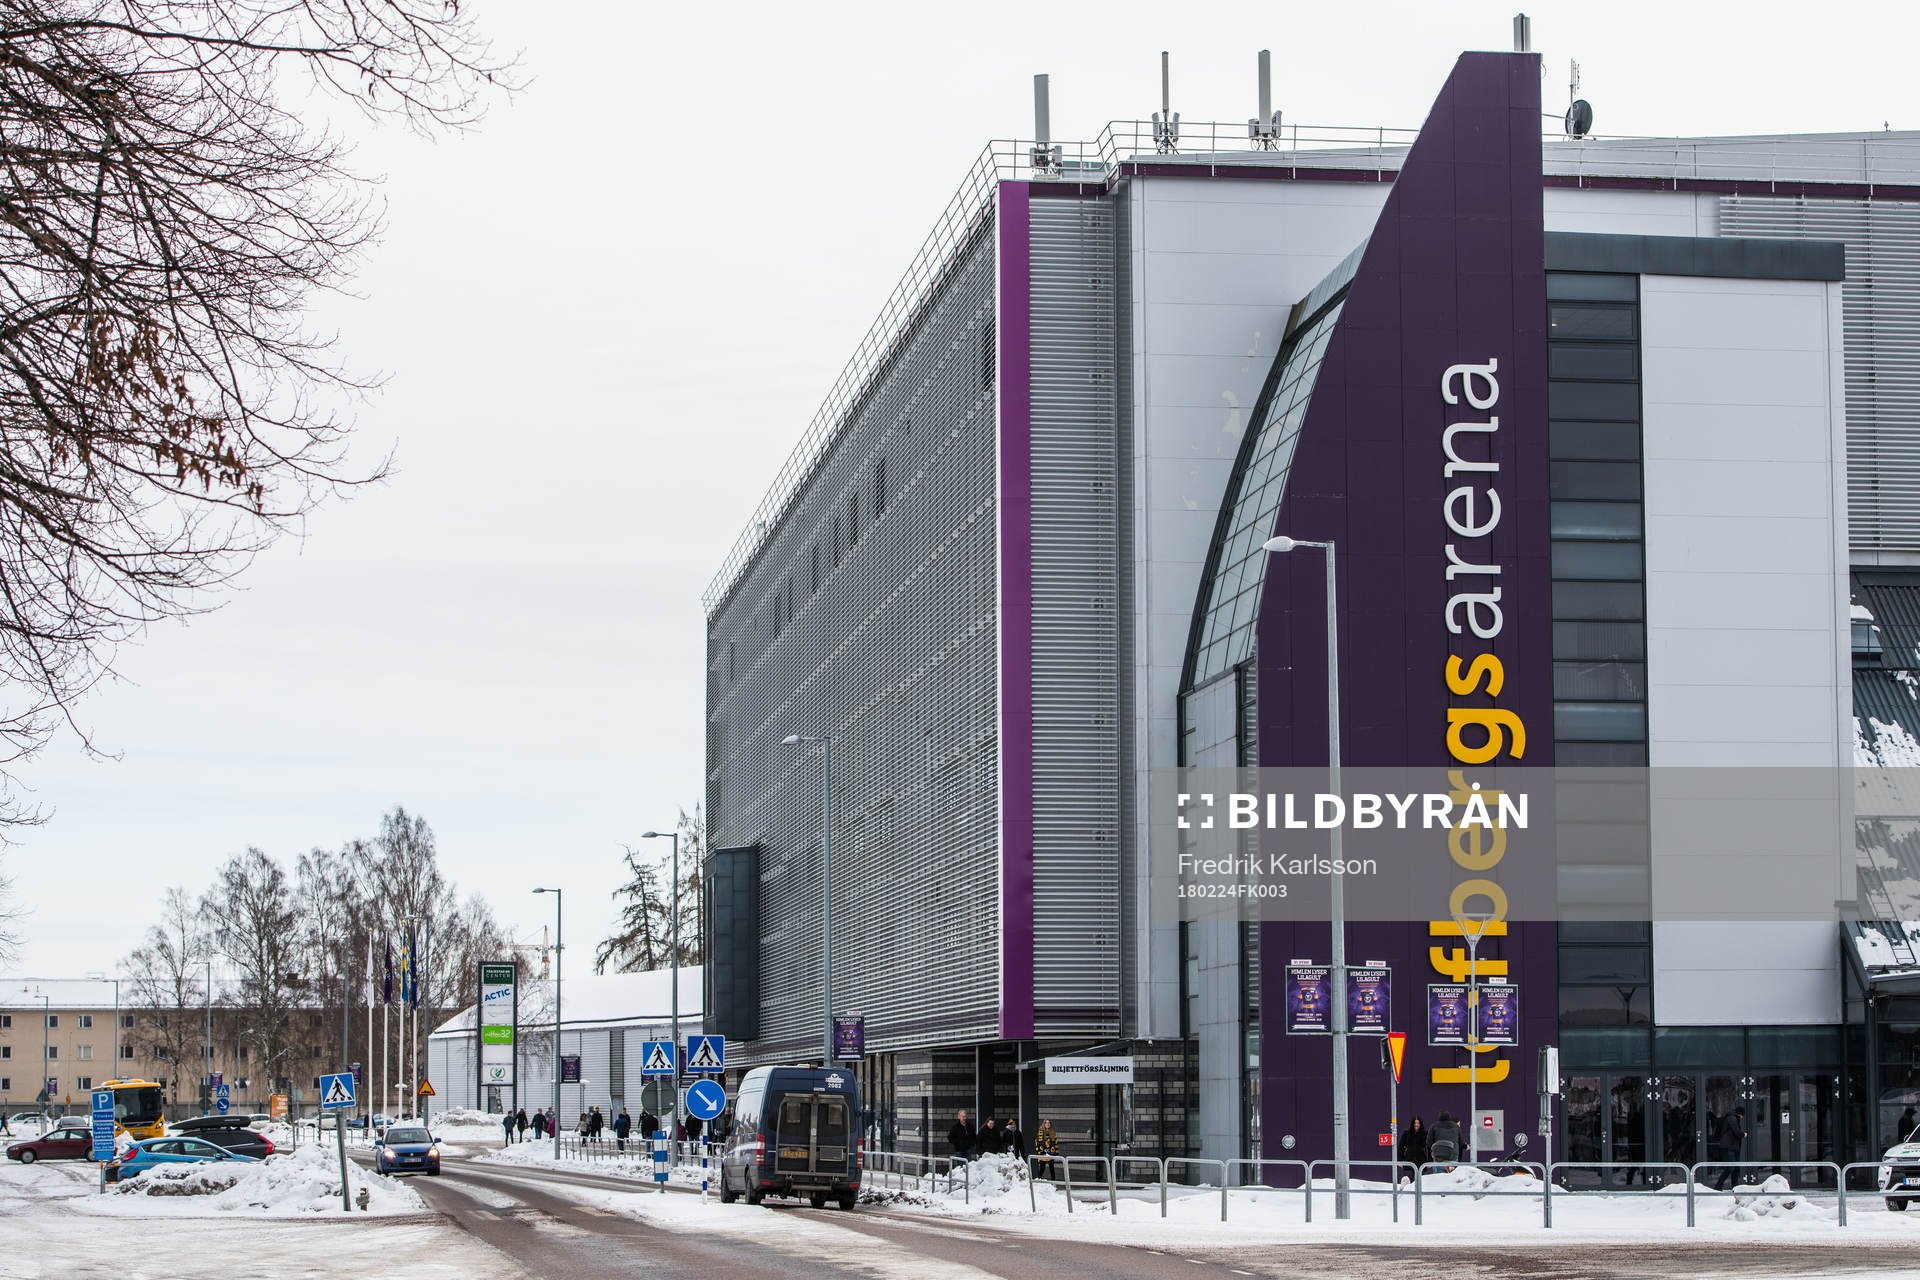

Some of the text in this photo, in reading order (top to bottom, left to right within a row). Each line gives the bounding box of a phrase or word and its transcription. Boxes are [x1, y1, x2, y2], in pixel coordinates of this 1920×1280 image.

[1429, 357, 1526, 1084] lfbergsarena
[484, 988, 511, 1001] ACTIC
[1052, 1064, 1129, 1073] BILJETTFÖRSÄLJNING
[98, 1094, 109, 1108] P
